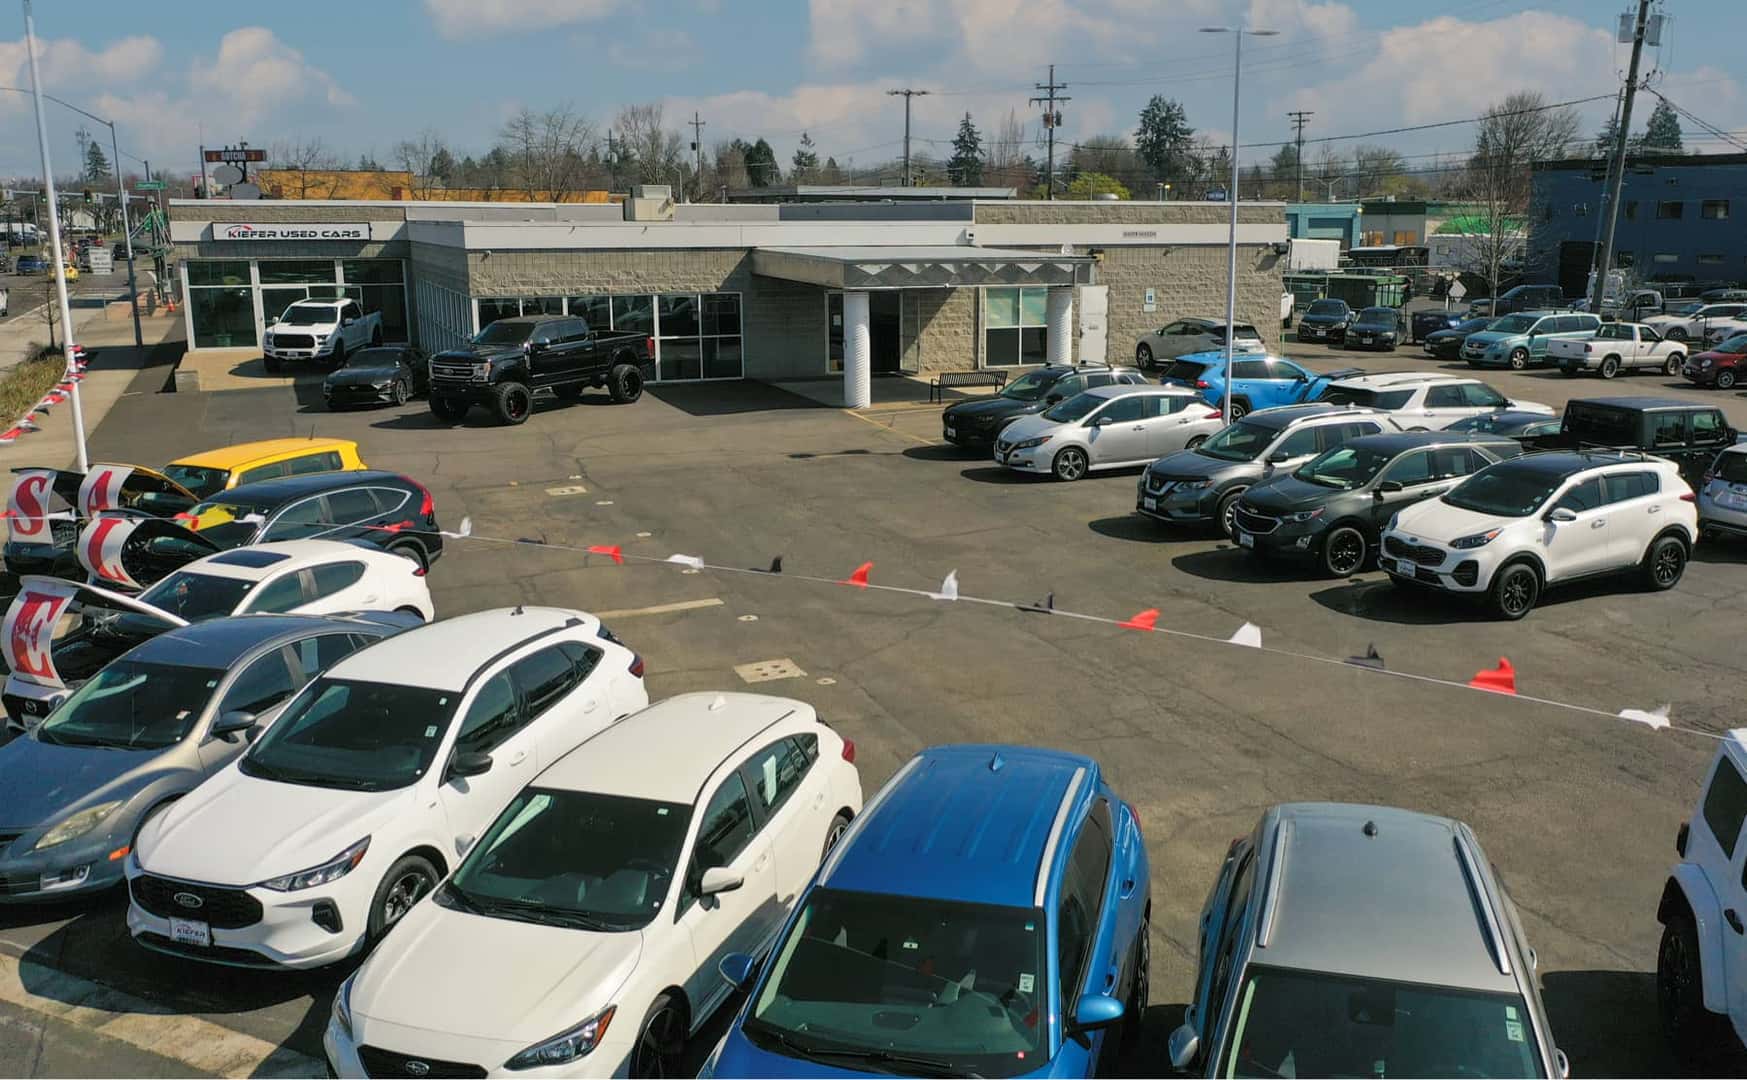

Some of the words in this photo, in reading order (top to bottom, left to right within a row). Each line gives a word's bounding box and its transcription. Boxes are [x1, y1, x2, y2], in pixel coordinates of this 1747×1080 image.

[228, 230, 277, 239] KIEFER
[280, 230, 318, 239] USED
[321, 230, 361, 239] CARS
[15, 476, 48, 535] S
